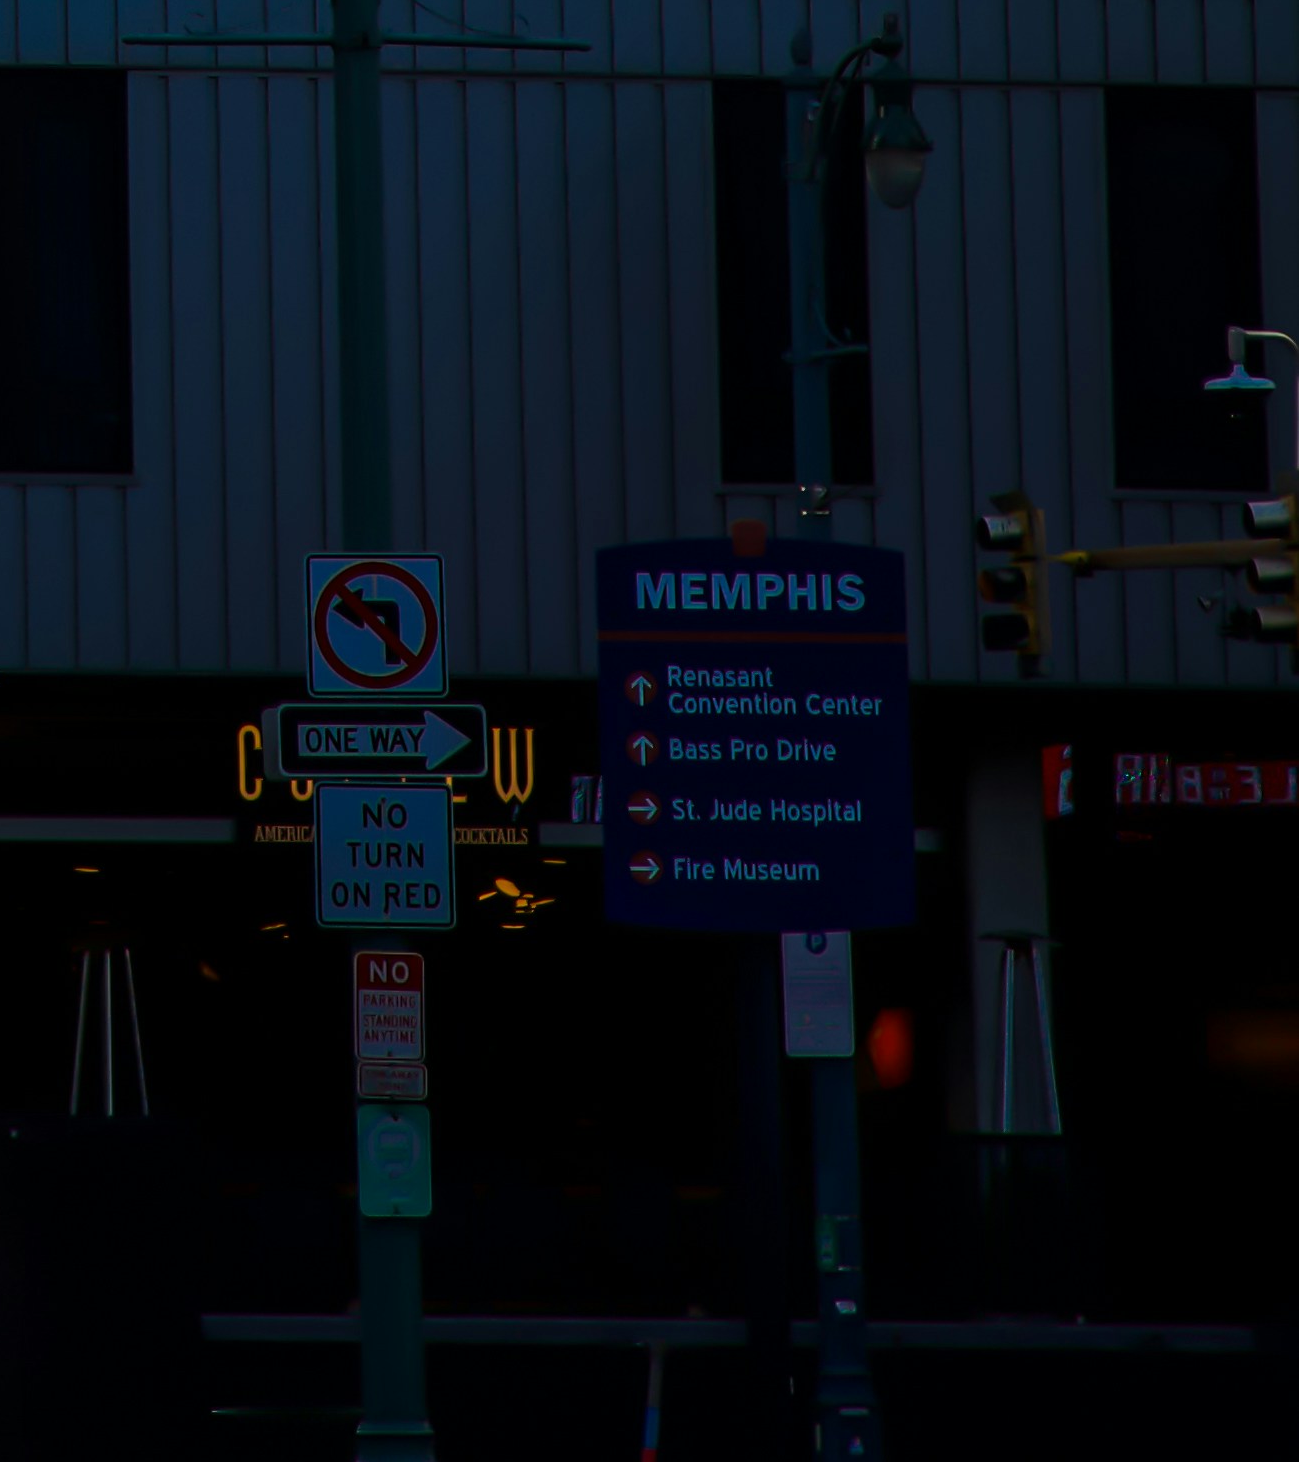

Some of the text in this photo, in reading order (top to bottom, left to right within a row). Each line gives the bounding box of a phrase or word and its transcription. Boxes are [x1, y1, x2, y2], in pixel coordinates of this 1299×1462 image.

[635, 571, 867, 612] MEMPHIS
[667, 665, 774, 688] Renasant
[668, 692, 883, 717] Convention Center
[305, 727, 424, 753] ONE WAY
[668, 738, 838, 762] Bass Pro Drive
[362, 802, 408, 830] NO
[672, 798, 863, 827] St. Jude Hospital
[453, 827, 529, 845] COCKTAILS
[346, 842, 424, 869] TURN
[673, 857, 820, 882] Fire Museum
[331, 882, 442, 911] ON RED
[369, 959, 411, 985] NO
[362, 993, 416, 1008] PARKING
[362, 1013, 418, 1029] STANDING
[363, 1029, 417, 1045] ANYTIME
